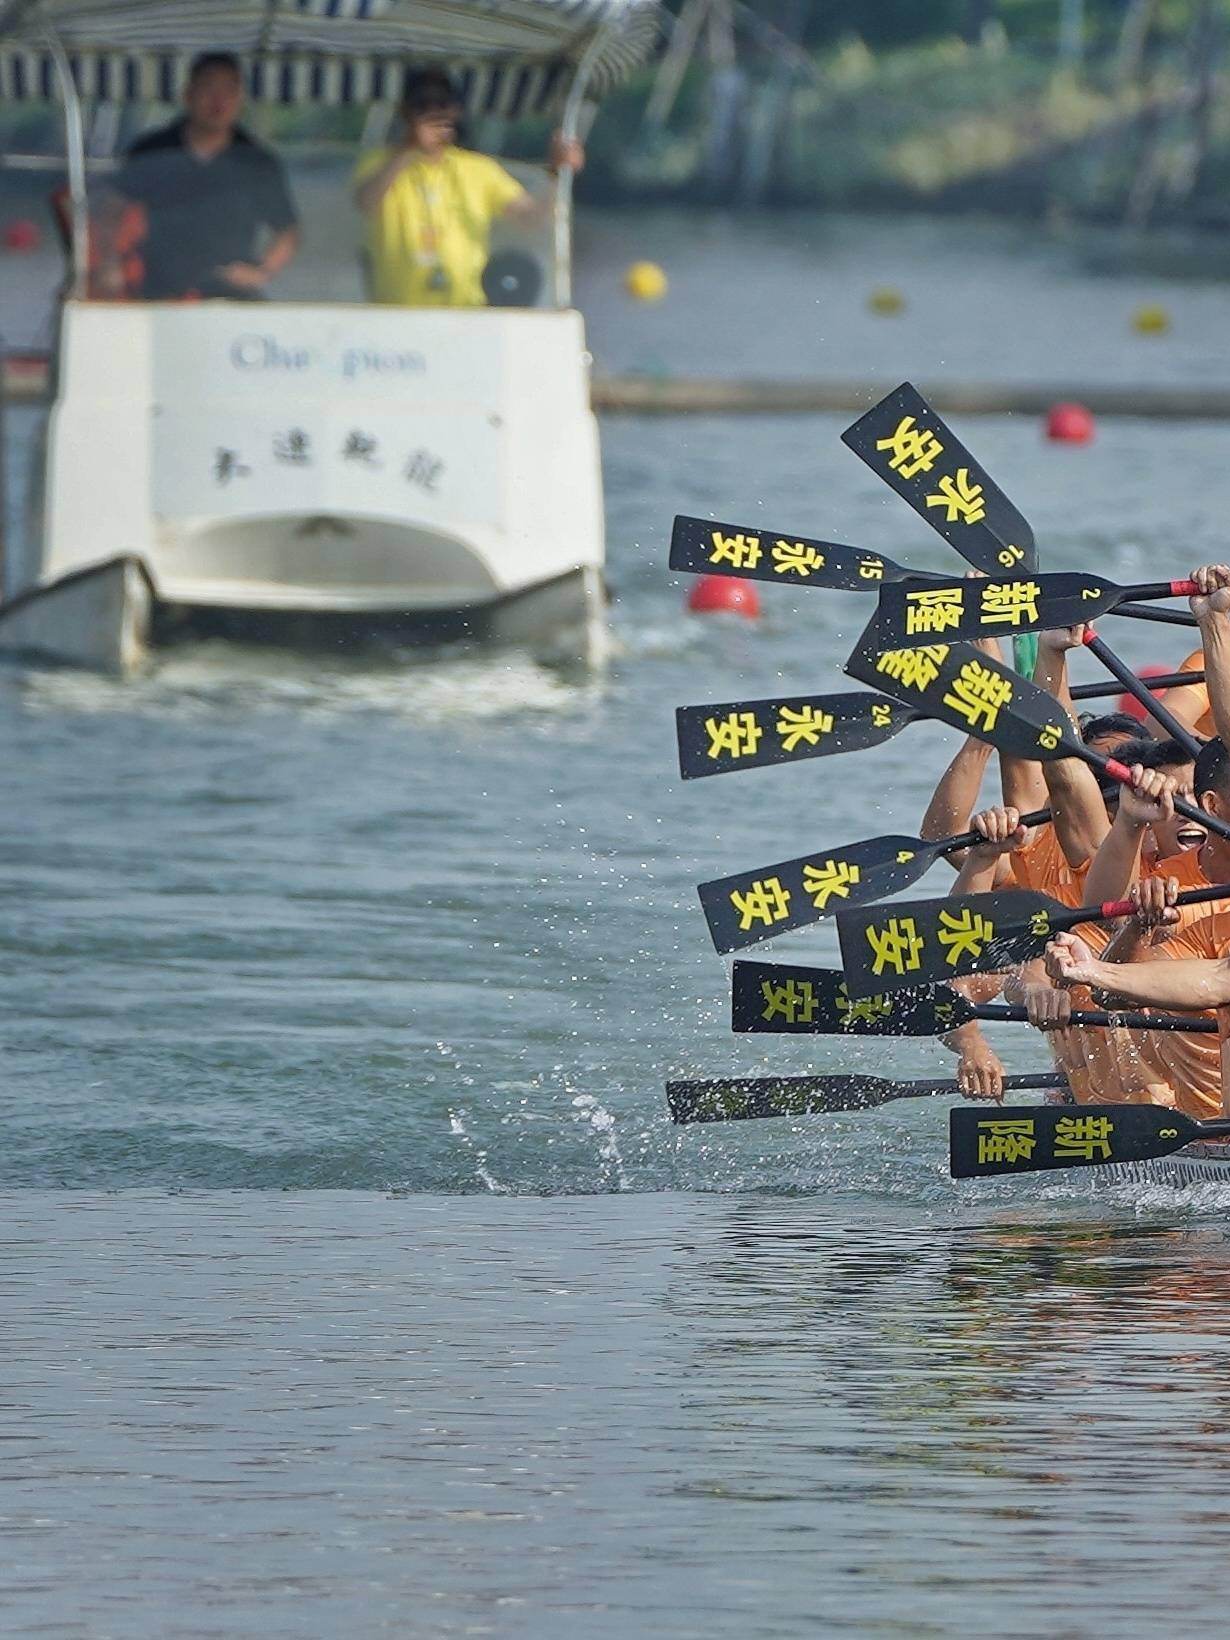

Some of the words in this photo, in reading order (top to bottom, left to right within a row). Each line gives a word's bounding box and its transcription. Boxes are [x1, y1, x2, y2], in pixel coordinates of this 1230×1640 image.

[876, 415, 986, 526] 永安
[709, 532, 825, 576] 永安
[861, 560, 883, 580] 15
[999, 545, 1024, 567] 16
[906, 582, 1042, 634] 新隆
[1083, 588, 1101, 599] 2
[706, 705, 834, 758] 永安
[872, 705, 892, 728] 24
[1039, 725, 1062, 750] 19
[730, 859, 860, 931] 永安
[866, 909, 994, 975] 永安
[977, 1116, 1115, 1164] 新隆
[1159, 1128, 1177, 1140] 8
